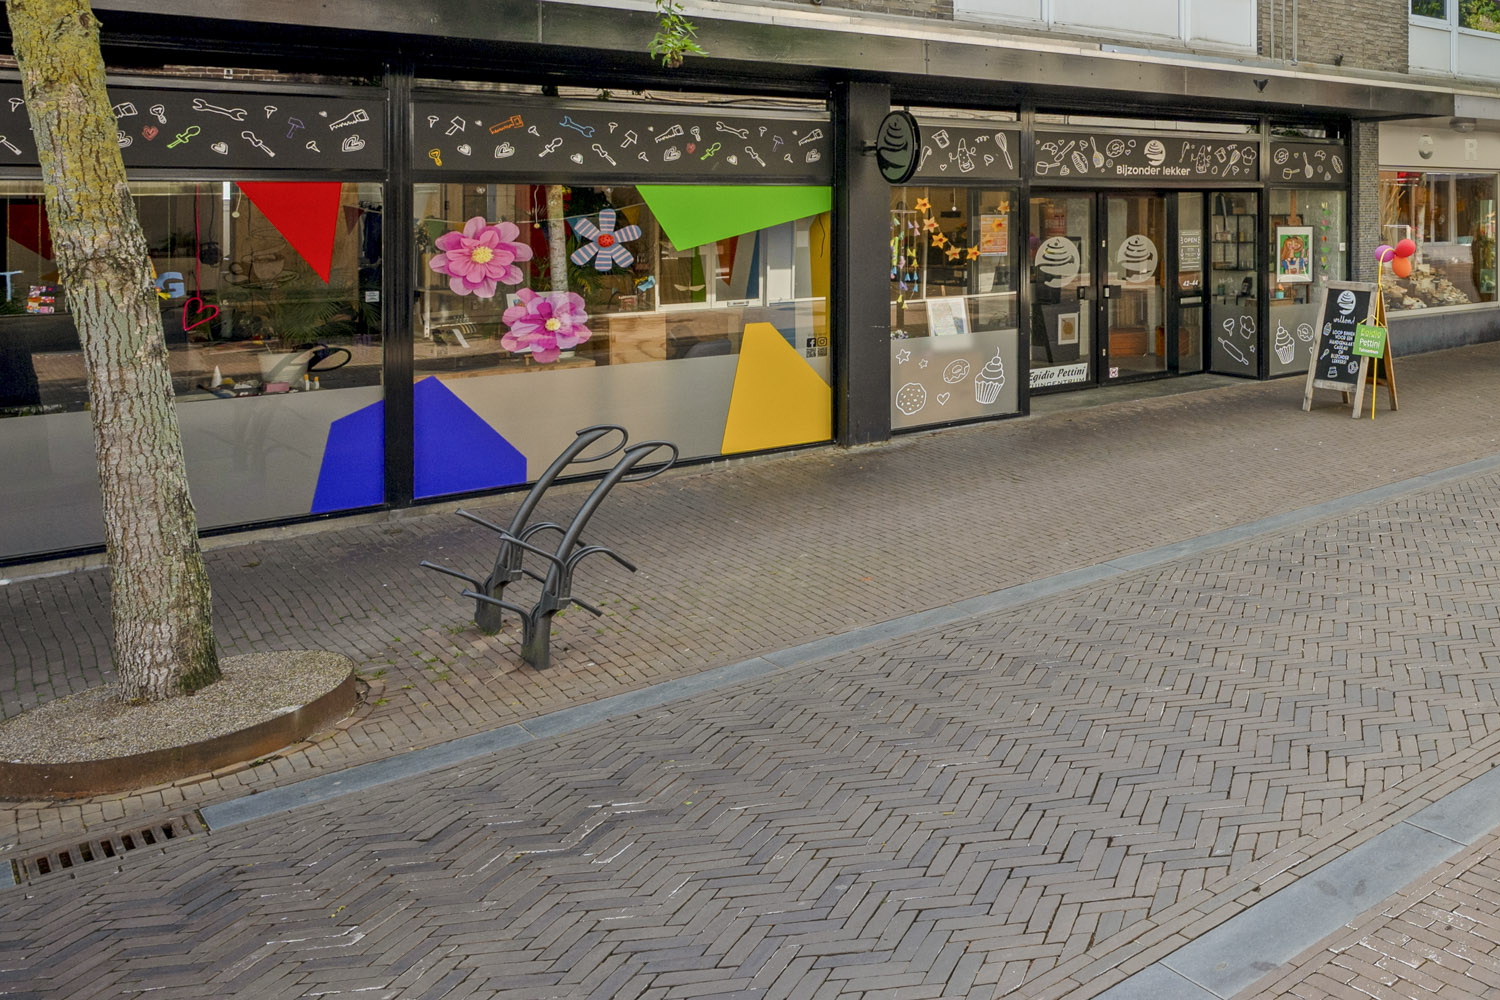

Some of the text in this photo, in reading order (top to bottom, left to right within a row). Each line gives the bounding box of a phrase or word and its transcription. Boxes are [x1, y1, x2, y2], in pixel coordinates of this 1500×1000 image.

[1116, 164, 1191, 176] Bijzonder lekker
[1359, 337, 1380, 349] Pettini
[1030, 366, 1086, 383] Egidio Pettini
